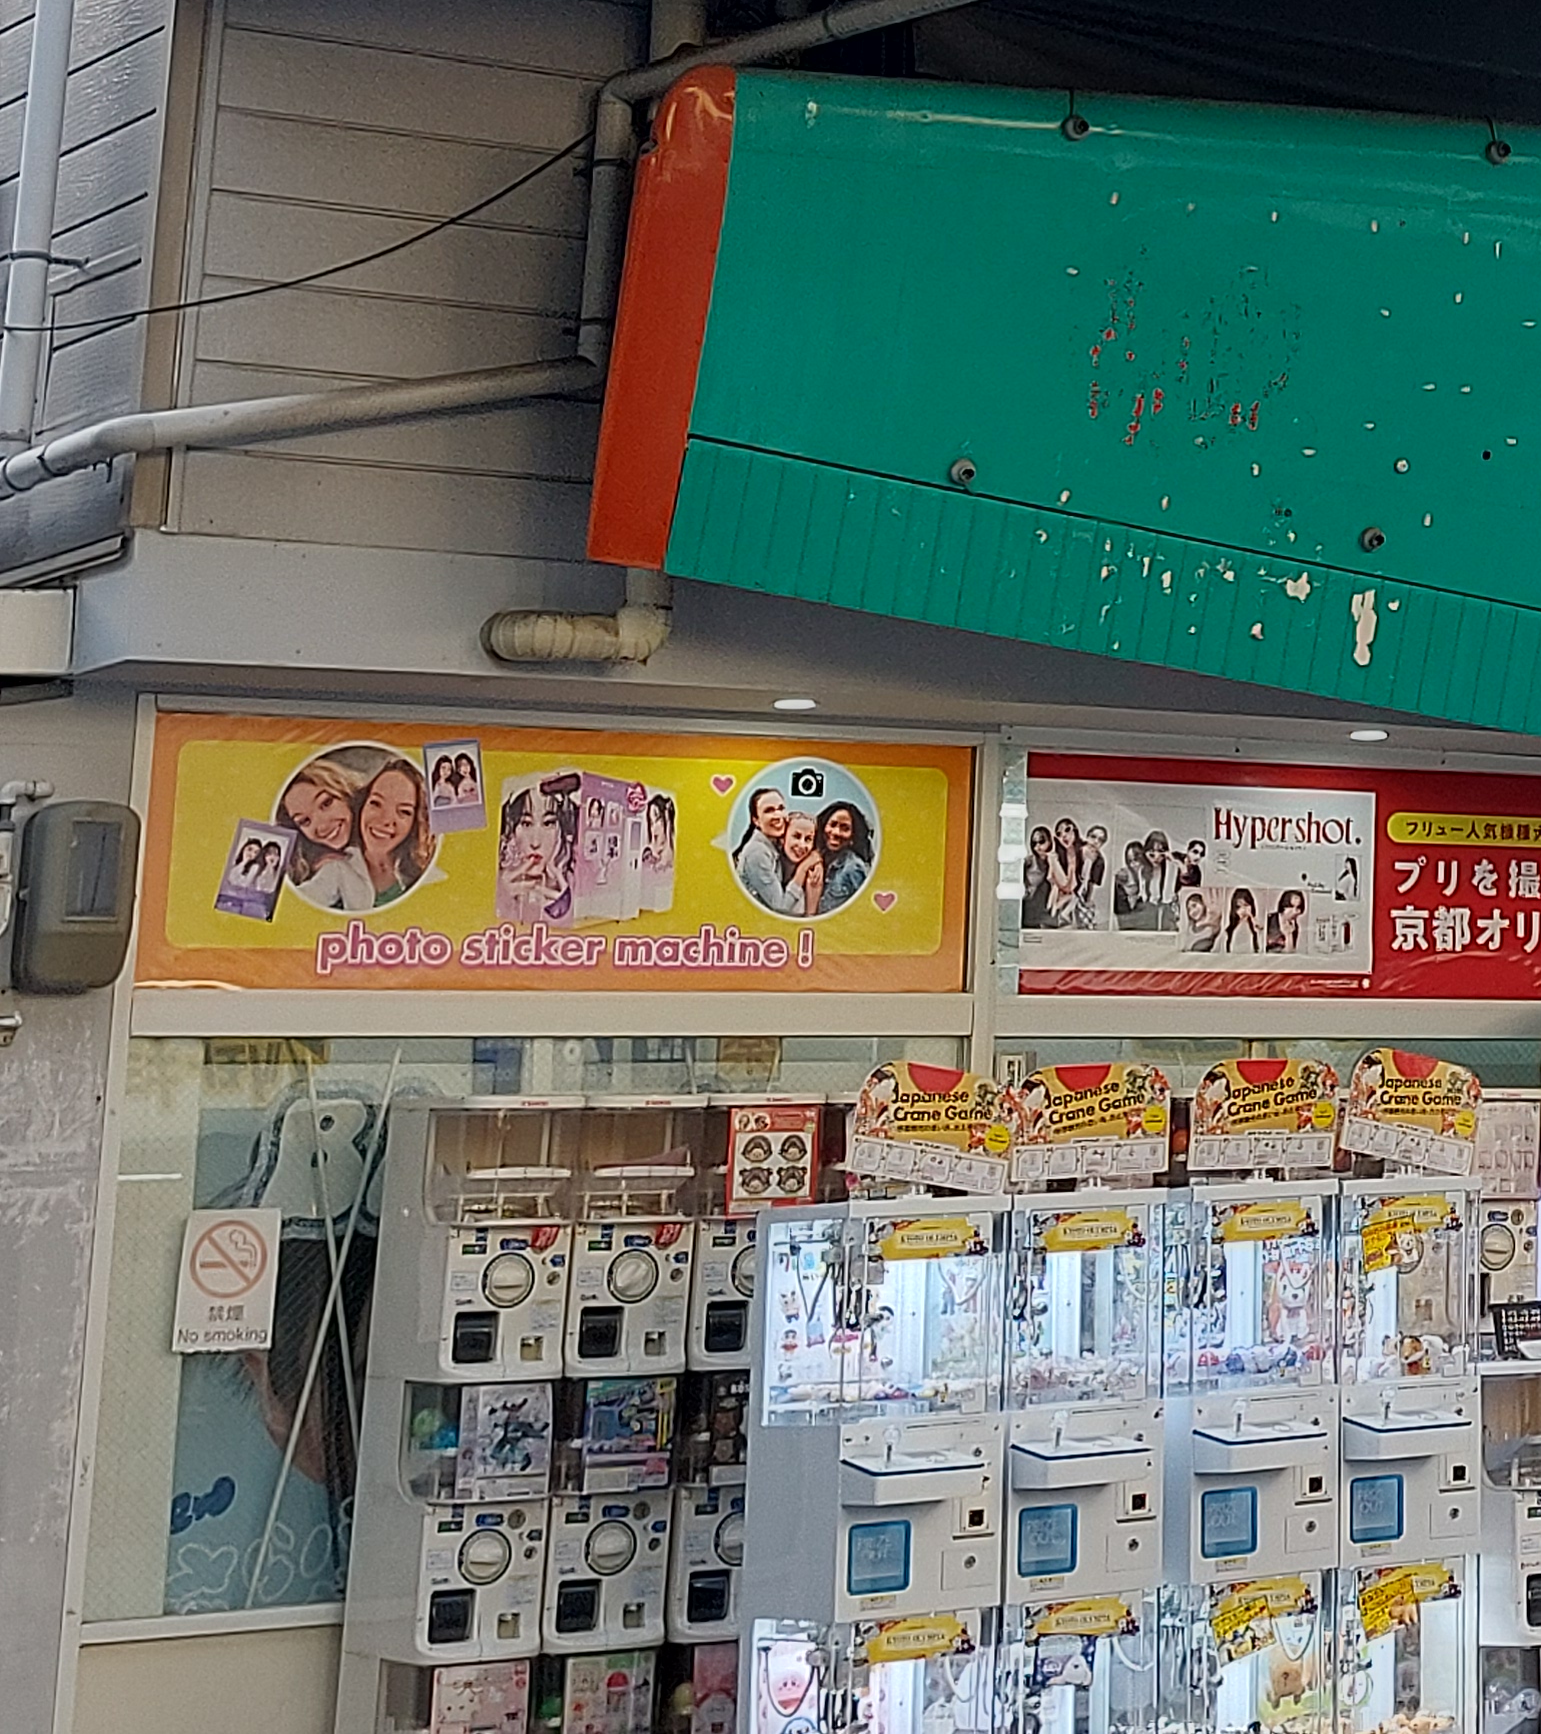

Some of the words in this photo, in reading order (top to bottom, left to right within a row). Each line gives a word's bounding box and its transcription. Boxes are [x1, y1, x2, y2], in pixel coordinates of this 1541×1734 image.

[1213, 807, 1362, 849] Hypershot.
[316, 920, 452, 974] photo
[461, 921, 606, 968] sticker
[613, 925, 789, 969] machine
[798, 929, 815, 969] !
[1225, 1076, 1296, 1101] Japanese
[1378, 1074, 1442, 1090] Japanese
[894, 1083, 970, 1104] Japanese
[1045, 1080, 1121, 1110] Japanese
[1098, 1093, 1146, 1113] Game
[1273, 1088, 1318, 1107] Game
[1421, 1091, 1463, 1106] Game
[944, 1104, 995, 1121] Game
[177, 1328, 199, 1344] No
[204, 1326, 268, 1345] smoking
